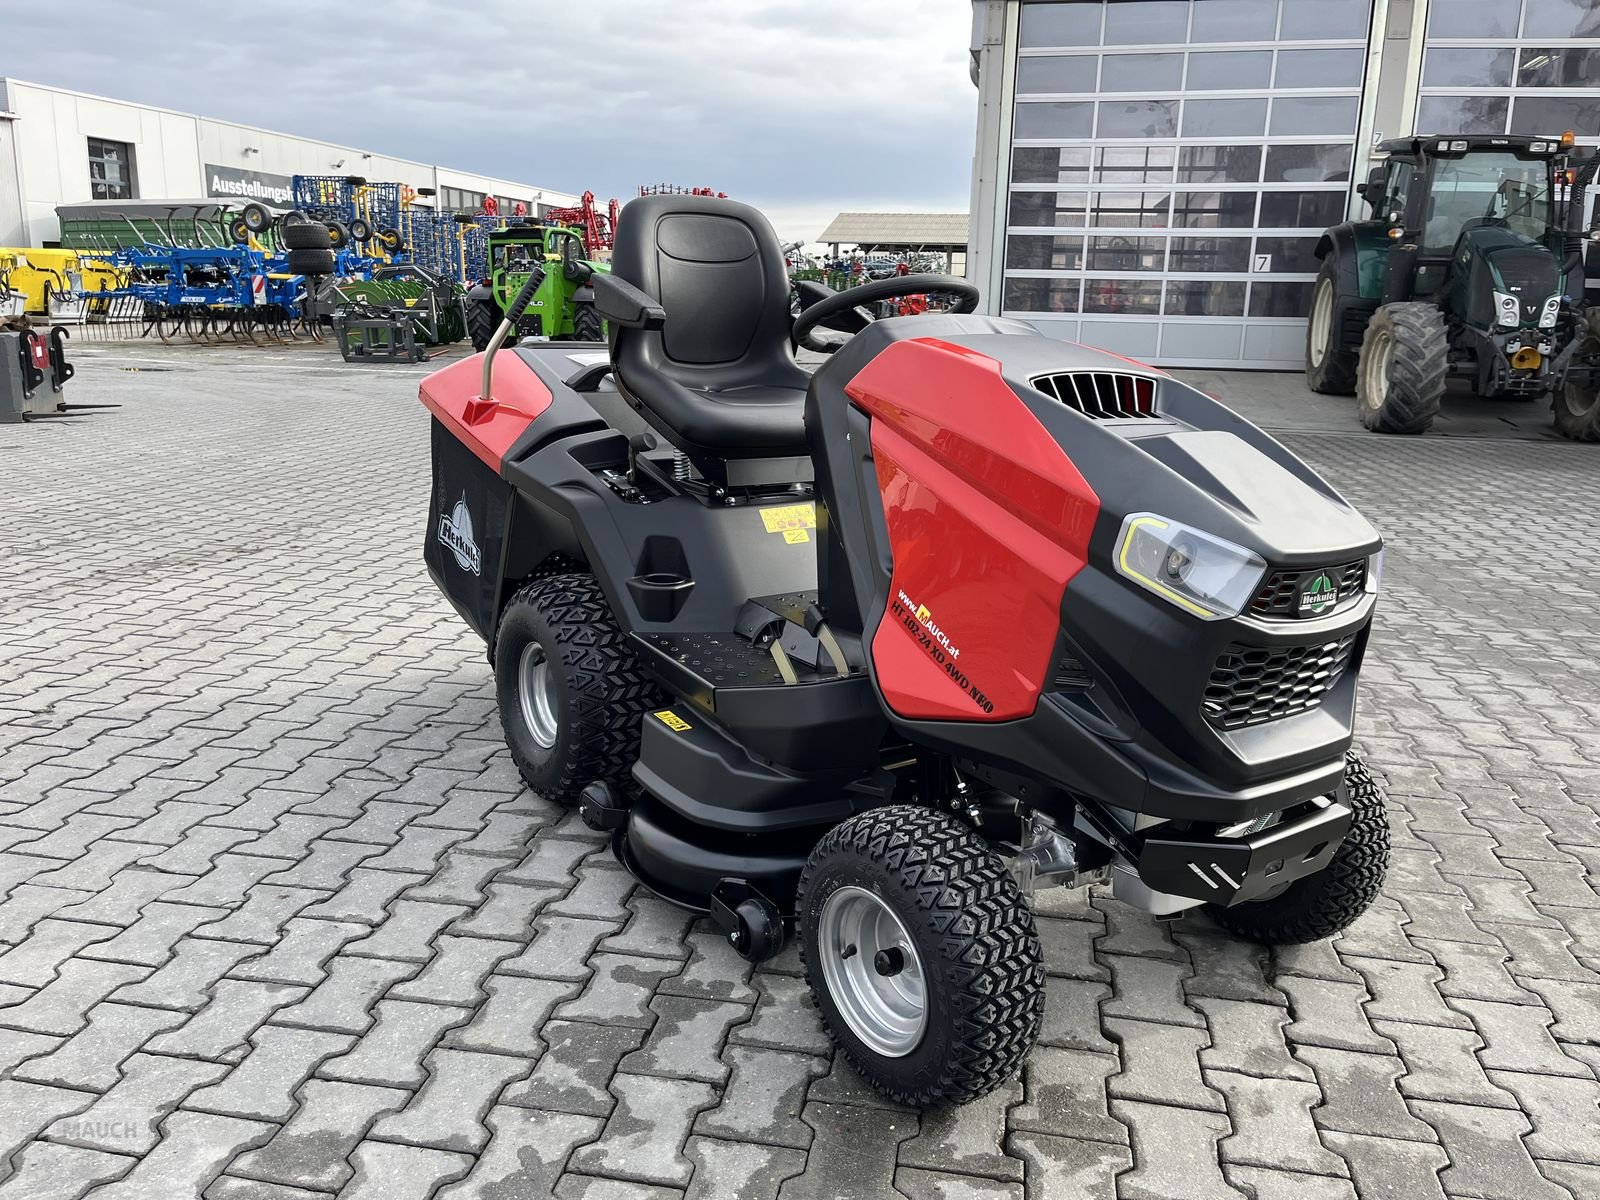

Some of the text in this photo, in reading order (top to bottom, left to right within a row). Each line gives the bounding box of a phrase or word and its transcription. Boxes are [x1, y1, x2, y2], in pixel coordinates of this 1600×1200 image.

[1257, 256, 1268, 271] 7
[891, 601, 994, 714] HT 102-24 XD 4WD NEO
[898, 589, 960, 659] www.MAUCH.at
